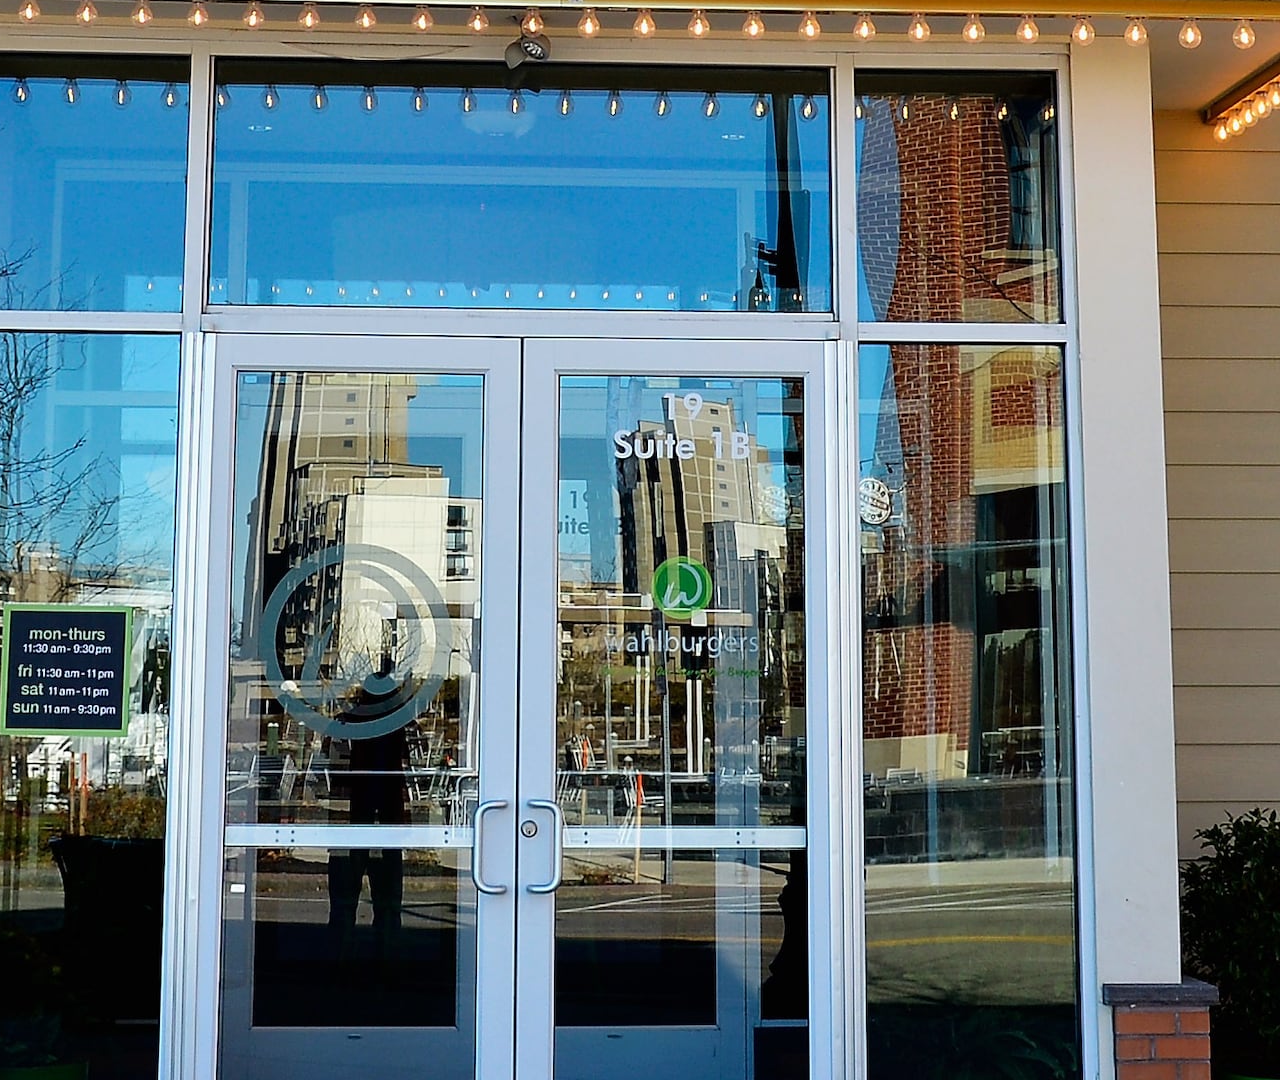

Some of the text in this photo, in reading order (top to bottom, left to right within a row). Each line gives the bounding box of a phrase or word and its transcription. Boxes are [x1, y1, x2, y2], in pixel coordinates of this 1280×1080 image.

[663, 392, 704, 421] 19
[614, 429, 750, 460] Suite 1B
[28, 627, 106, 641] mon-thurs
[23, 643, 48, 654] 11:30
[604, 630, 759, 658] wahlburgers
[17, 663, 33, 678] fri
[36, 668, 62, 678] 11:30
[20, 683, 45, 696] sat
[12, 702, 40, 714] sun
